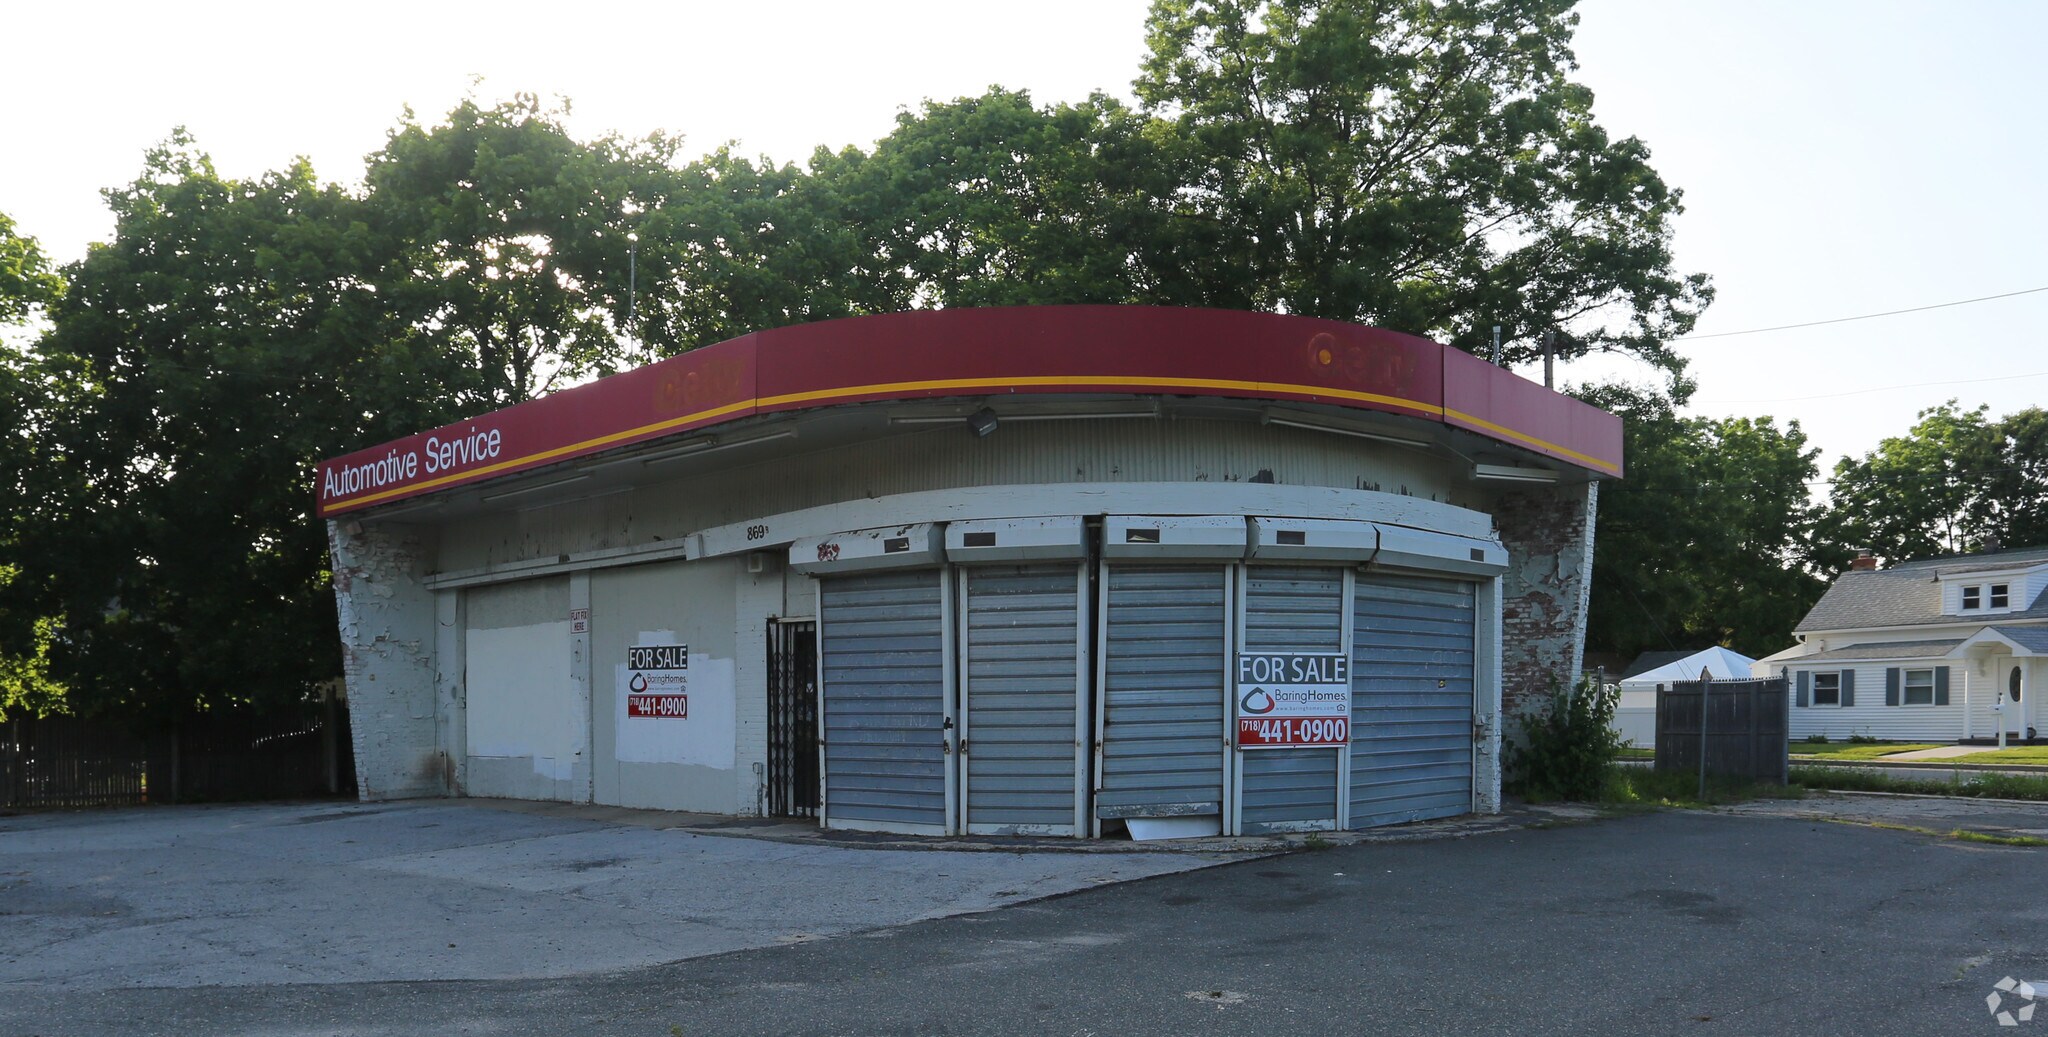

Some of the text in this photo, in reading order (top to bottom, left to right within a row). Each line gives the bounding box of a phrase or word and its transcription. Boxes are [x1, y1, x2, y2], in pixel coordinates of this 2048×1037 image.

[323, 426, 500, 499] Automotive Service
[747, 524, 765, 541] 869
[630, 648, 686, 668] FOR SALE
[1240, 656, 1346, 682] FOR SALE
[639, 697, 686, 715] 441-0900
[1241, 720, 1346, 742] (718) 441-0900
